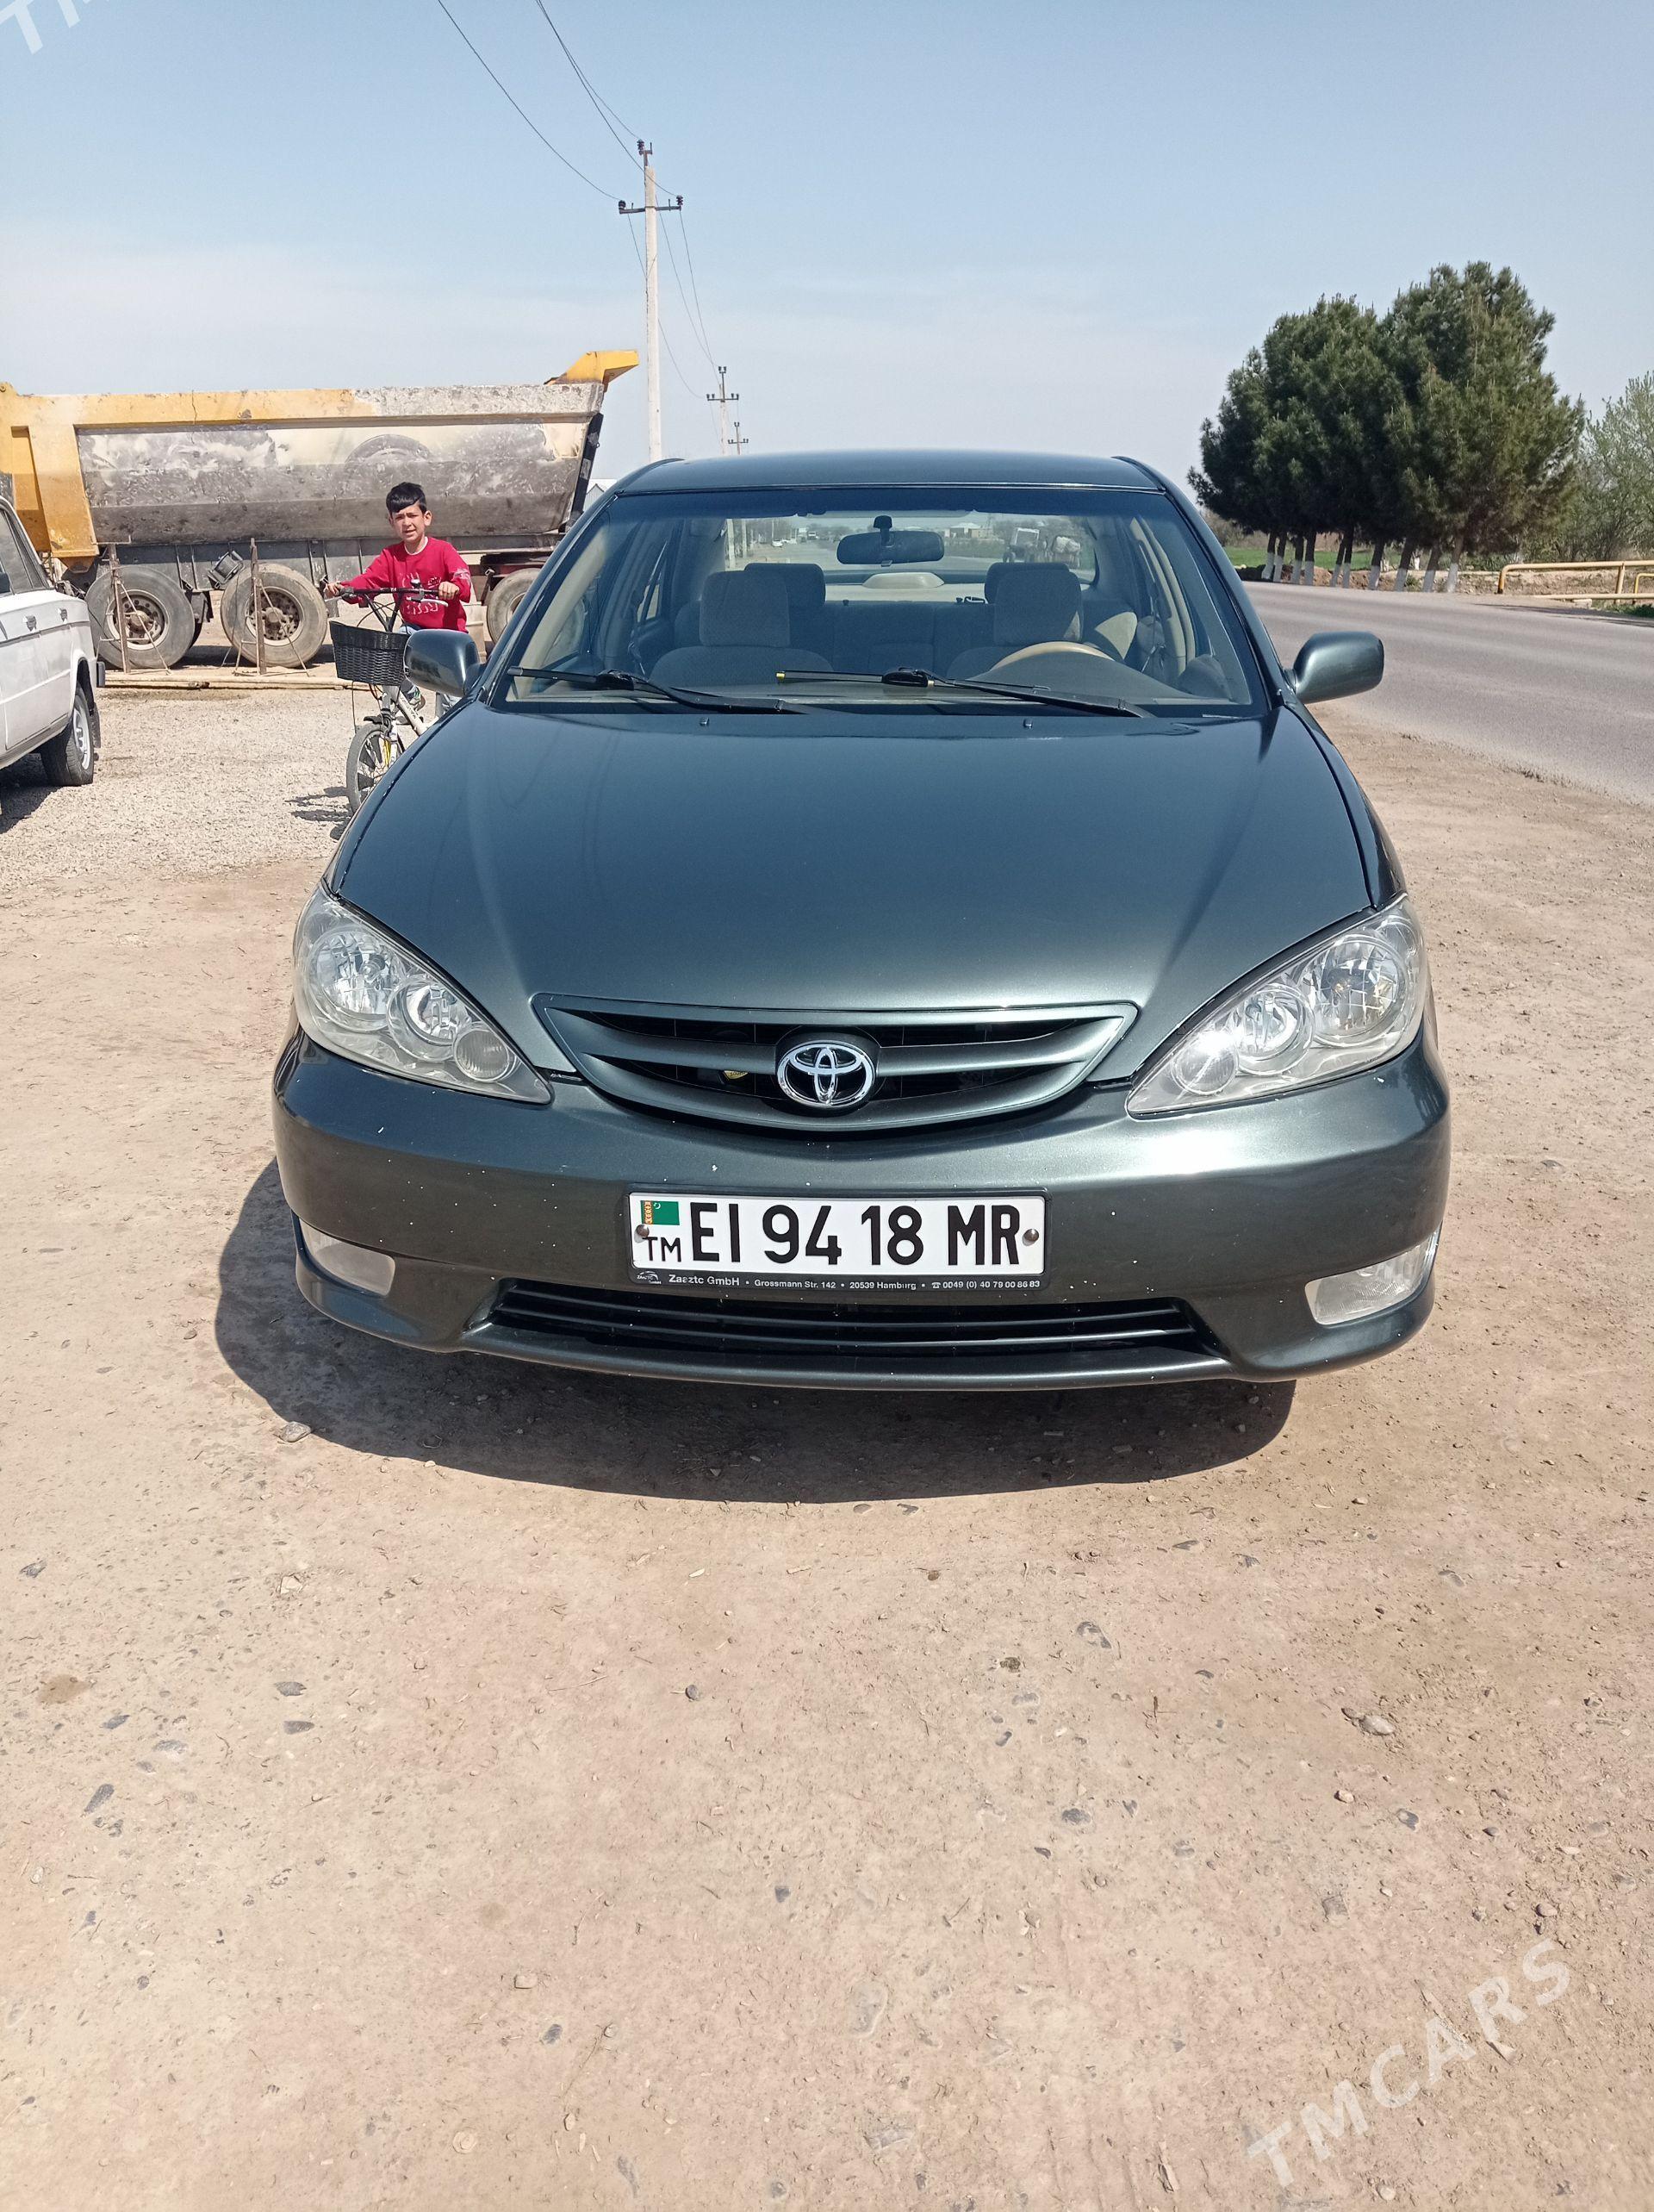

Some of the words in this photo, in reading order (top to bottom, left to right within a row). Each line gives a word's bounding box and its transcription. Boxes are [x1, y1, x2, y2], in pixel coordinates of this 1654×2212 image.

[690, 1202, 740, 1262] EI
[948, 1205, 1020, 1266] MR
[642, 1237, 681, 1262] TM
[706, 1275, 740, 1286] GmbH
[754, 1279, 803, 1288] Grossmann
[876, 1280, 917, 1290] Hamburg
[942, 1280, 964, 1289] 0049
[966, 1280, 977, 1289] (0)
